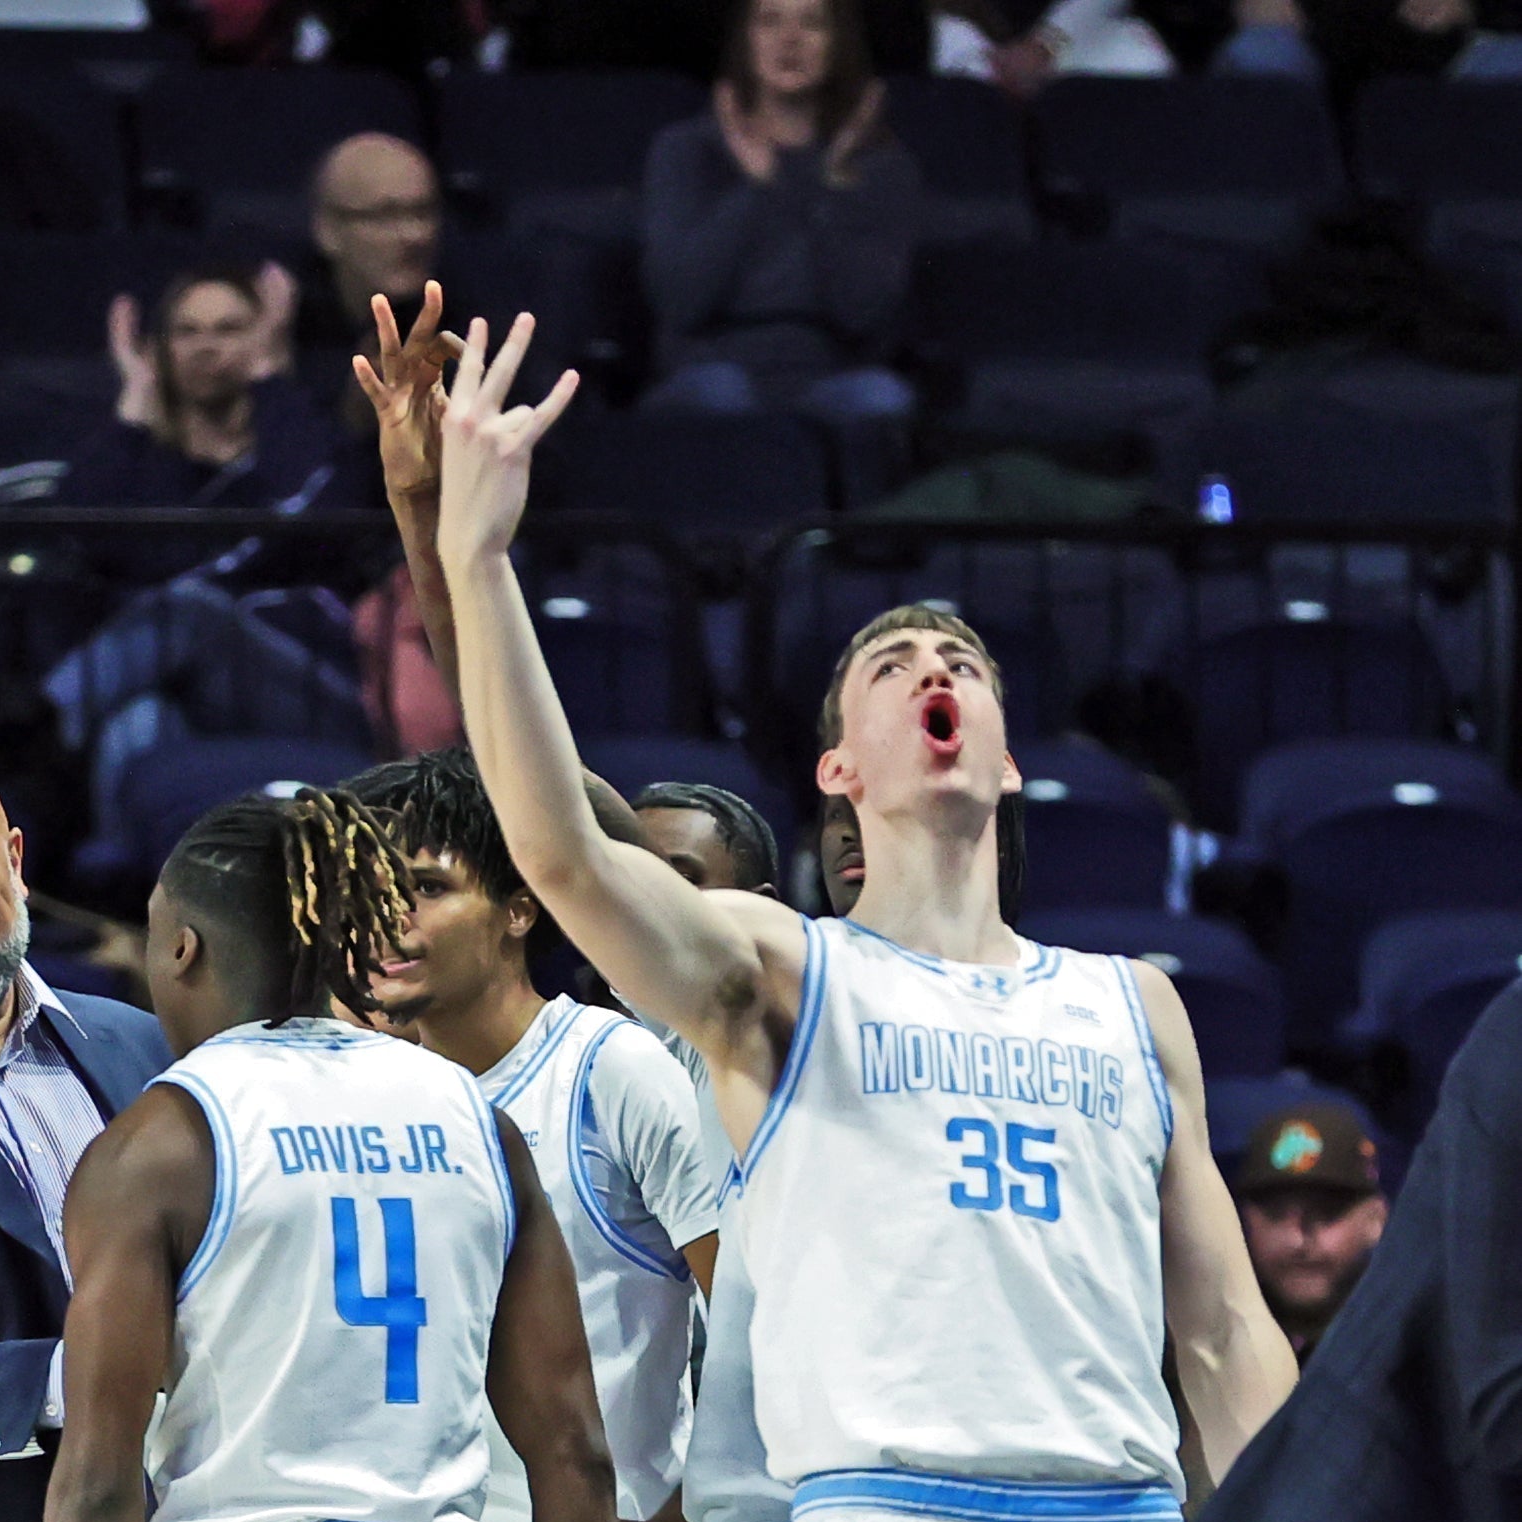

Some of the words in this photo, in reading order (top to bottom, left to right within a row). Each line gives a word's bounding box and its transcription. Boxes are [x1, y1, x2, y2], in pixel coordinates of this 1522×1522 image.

[859, 1021, 1124, 1130] MONARCHS
[269, 1125, 391, 1175] DAVIS
[399, 1124, 463, 1175] JR.
[946, 1116, 1061, 1222] 35
[331, 1196, 427, 1404] 4
